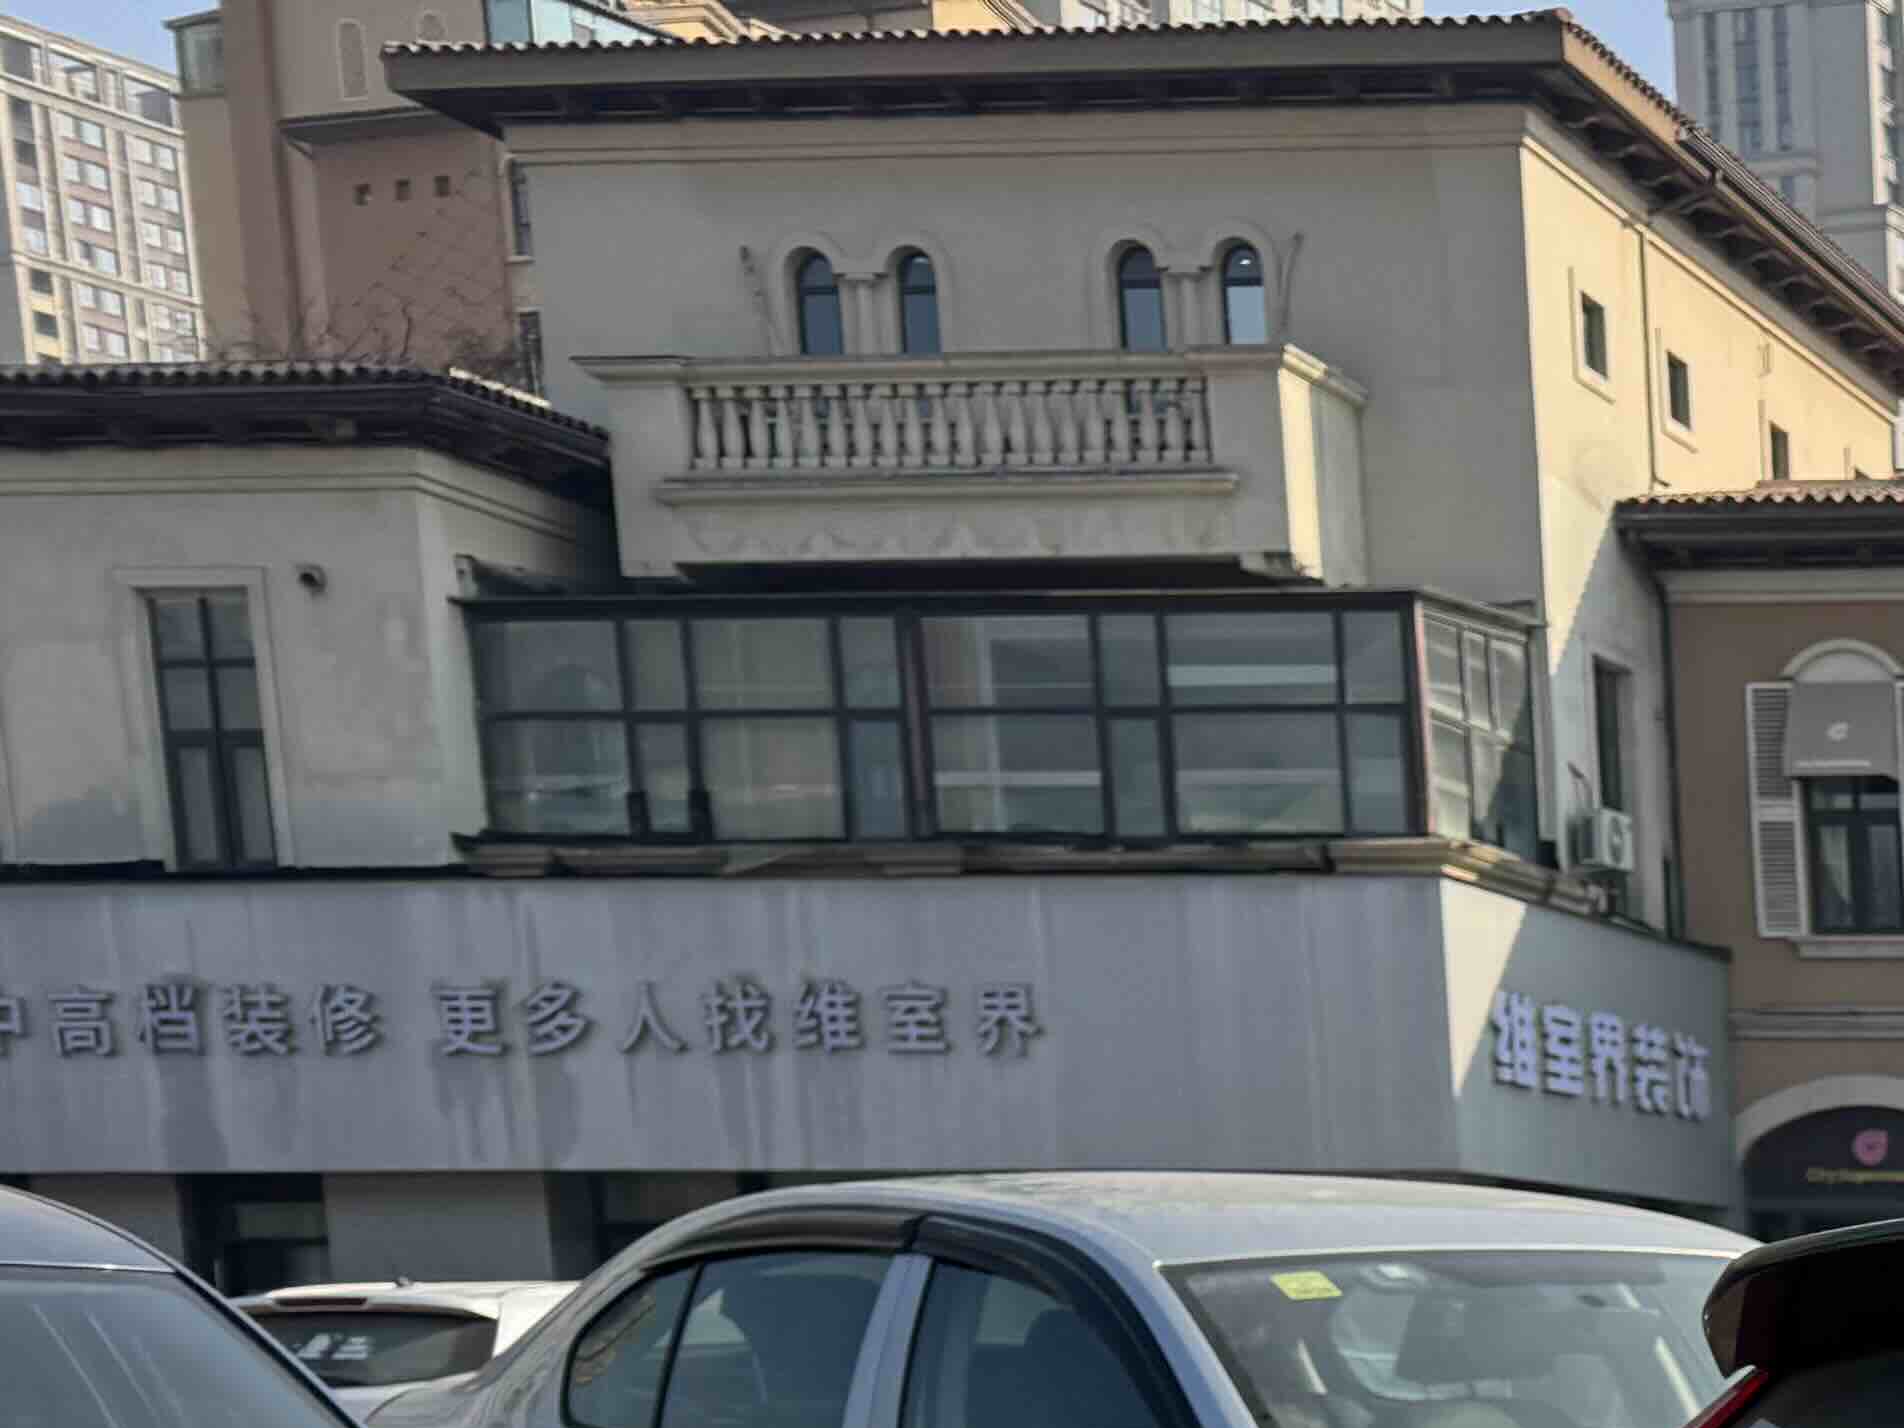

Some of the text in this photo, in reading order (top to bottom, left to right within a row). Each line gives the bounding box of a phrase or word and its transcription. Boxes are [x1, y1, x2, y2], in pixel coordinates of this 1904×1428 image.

[438, 980, 1046, 1060] 更多人找维室界
[1491, 990, 1712, 1121] 维室界装饰
